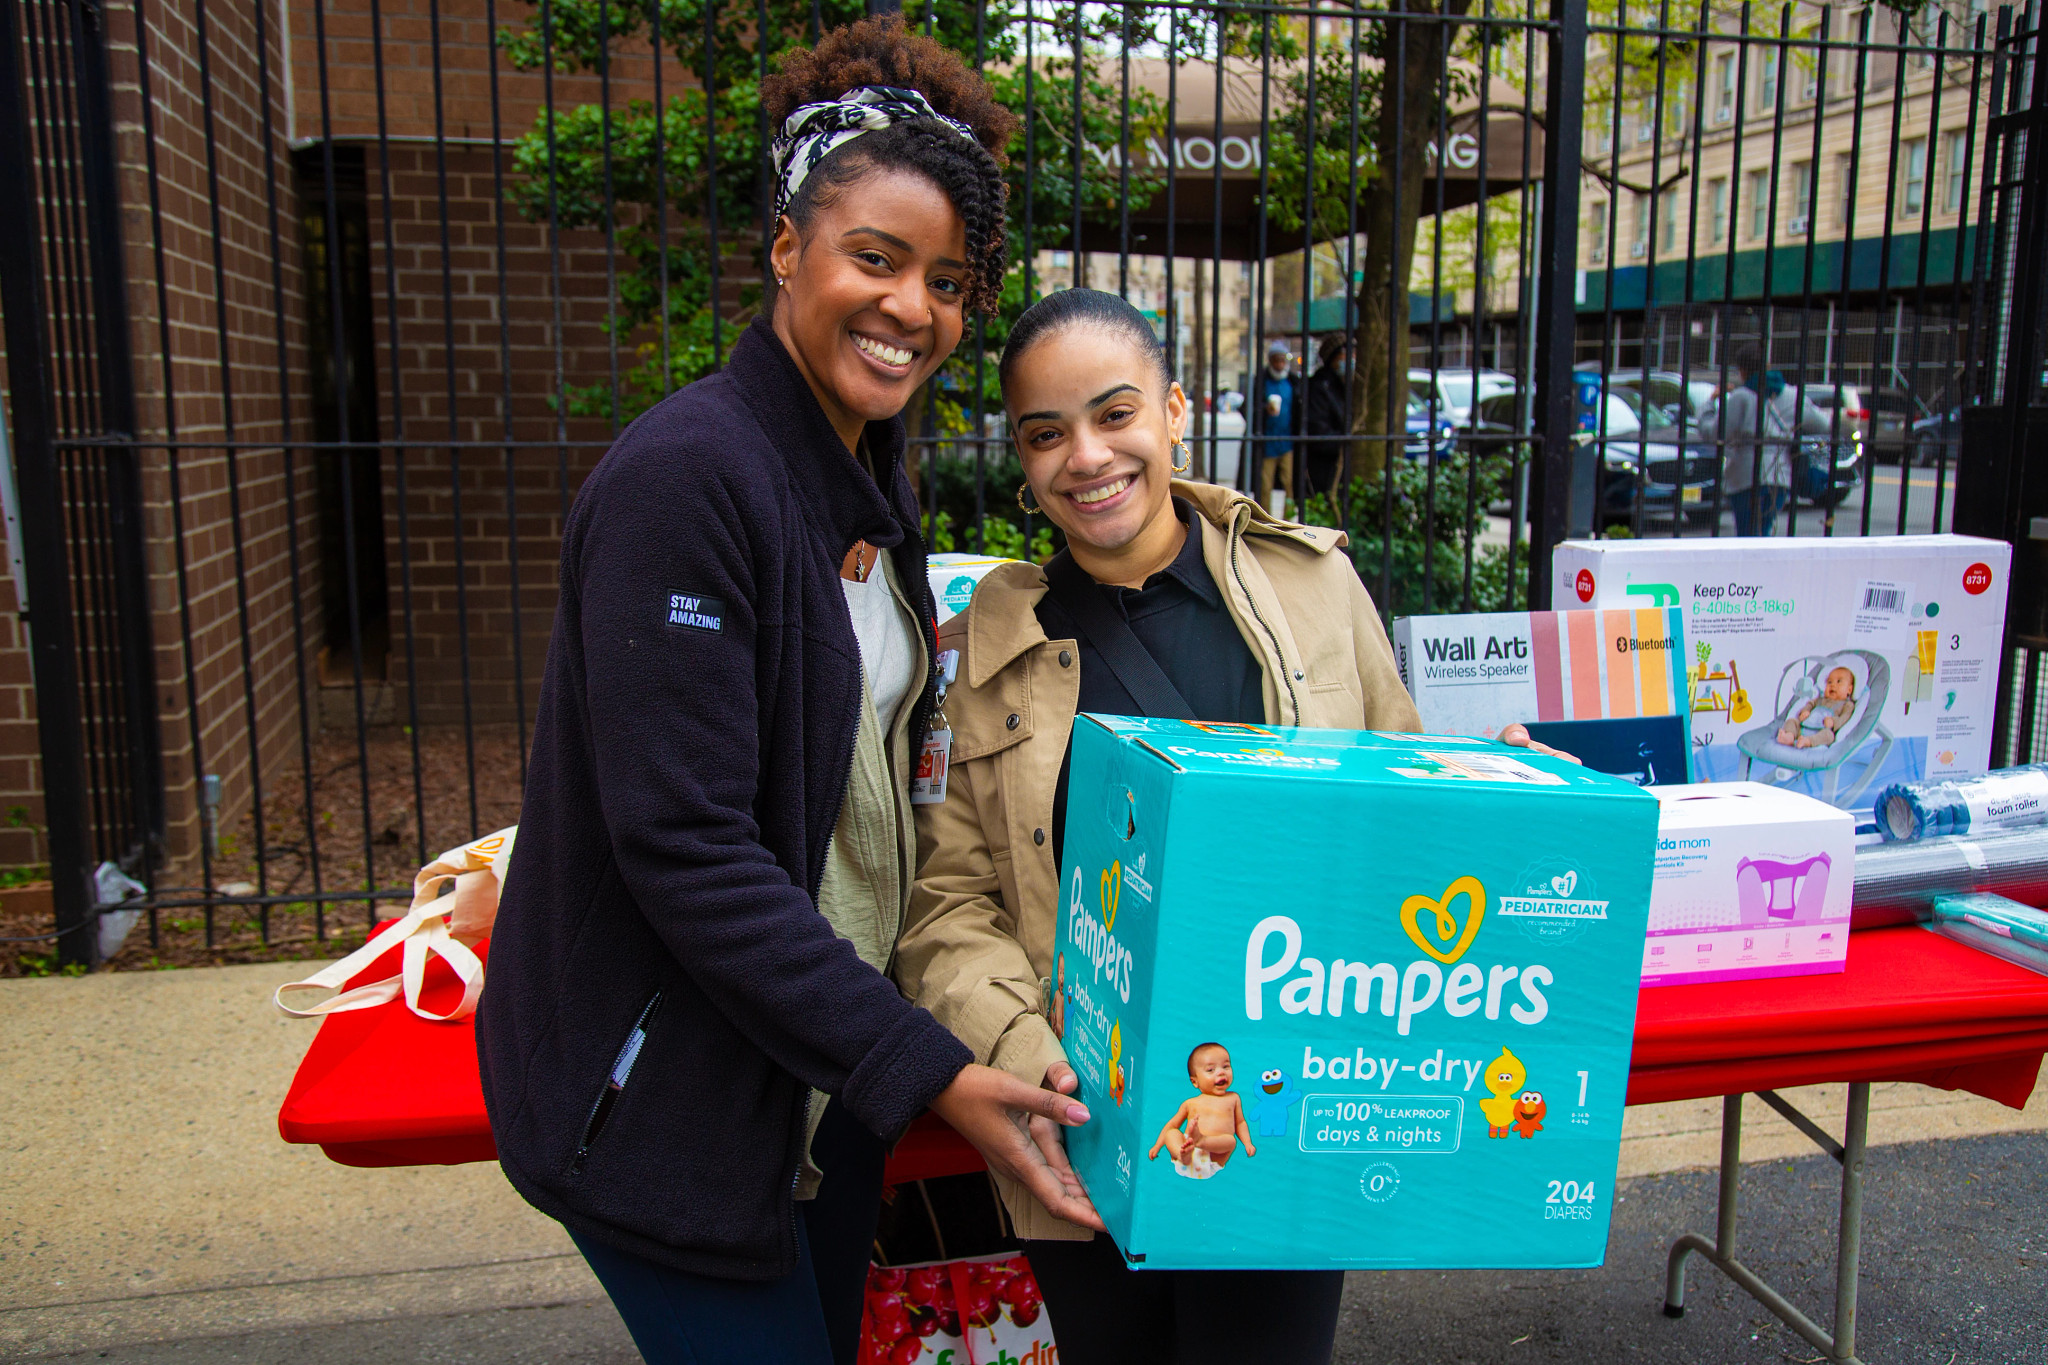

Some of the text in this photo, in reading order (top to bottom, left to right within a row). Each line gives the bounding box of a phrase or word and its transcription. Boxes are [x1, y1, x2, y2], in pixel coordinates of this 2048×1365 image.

[1966, 575, 1987, 585] 8731
[1693, 583, 1725, 600] Keep
[670, 595, 700, 611] STAY
[1692, 599, 1795, 617] 6-40lbs (3-18kg)
[669, 609, 721, 631] AMAZING
[1422, 635, 1528, 662] Wall Art
[1950, 634, 1960, 650] 3
[1399, 642, 1409, 691] aker
[1424, 662, 1529, 679] Wireless Speaker
[1168, 746, 1341, 766] Pampers
[2014, 799, 2039, 811] roller
[1656, 837, 1711, 850] ida mom
[1526, 876, 1573, 897] Pampers #1
[1504, 901, 1603, 916] PEDIATRICIAN
[1069, 865, 1132, 1004] Pampers
[1245, 915, 1554, 1036] Pampers
[1074, 973, 1112, 1047] baby-dry
[1302, 1046, 1483, 1091] baby-dry
[1576, 1070, 1589, 1107] 1
[1313, 1101, 1451, 1121] UP TO 100% LEAKPROOF
[1316, 1125, 1442, 1147] days & nights
[1117, 1144, 1131, 1180] 204
[1545, 1179, 1596, 1205] 204
[1544, 1205, 1593, 1221] DIAPERS
